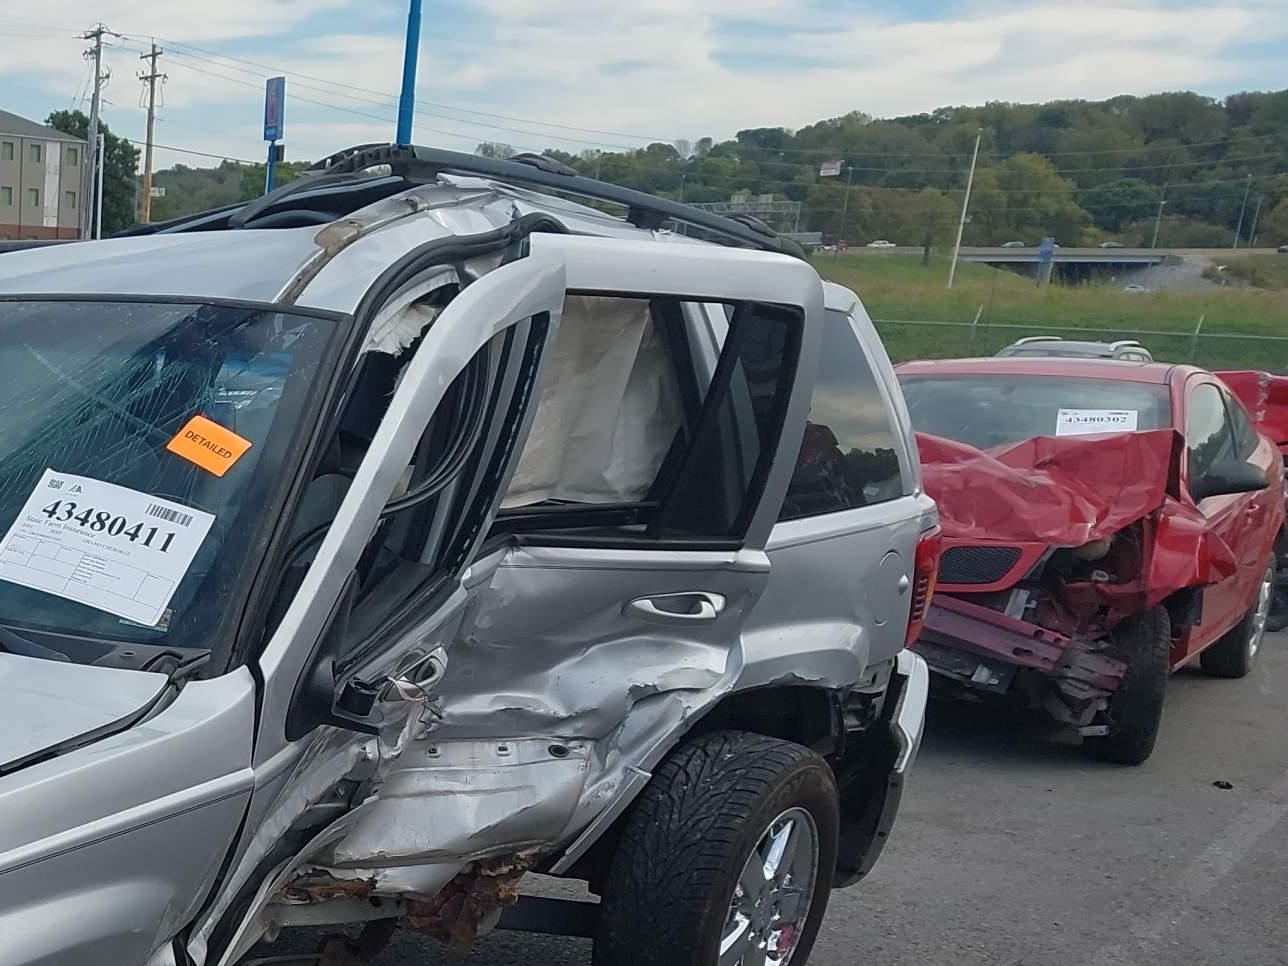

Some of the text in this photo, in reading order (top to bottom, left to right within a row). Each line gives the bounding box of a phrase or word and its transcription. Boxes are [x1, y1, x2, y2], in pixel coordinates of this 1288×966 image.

[184, 430, 233, 460] DETAILED
[25, 515, 43, 525] State
[44, 519, 62, 530] Farm
[62, 523, 96, 538] Insurance
[42, 500, 177, 554] 43480411
